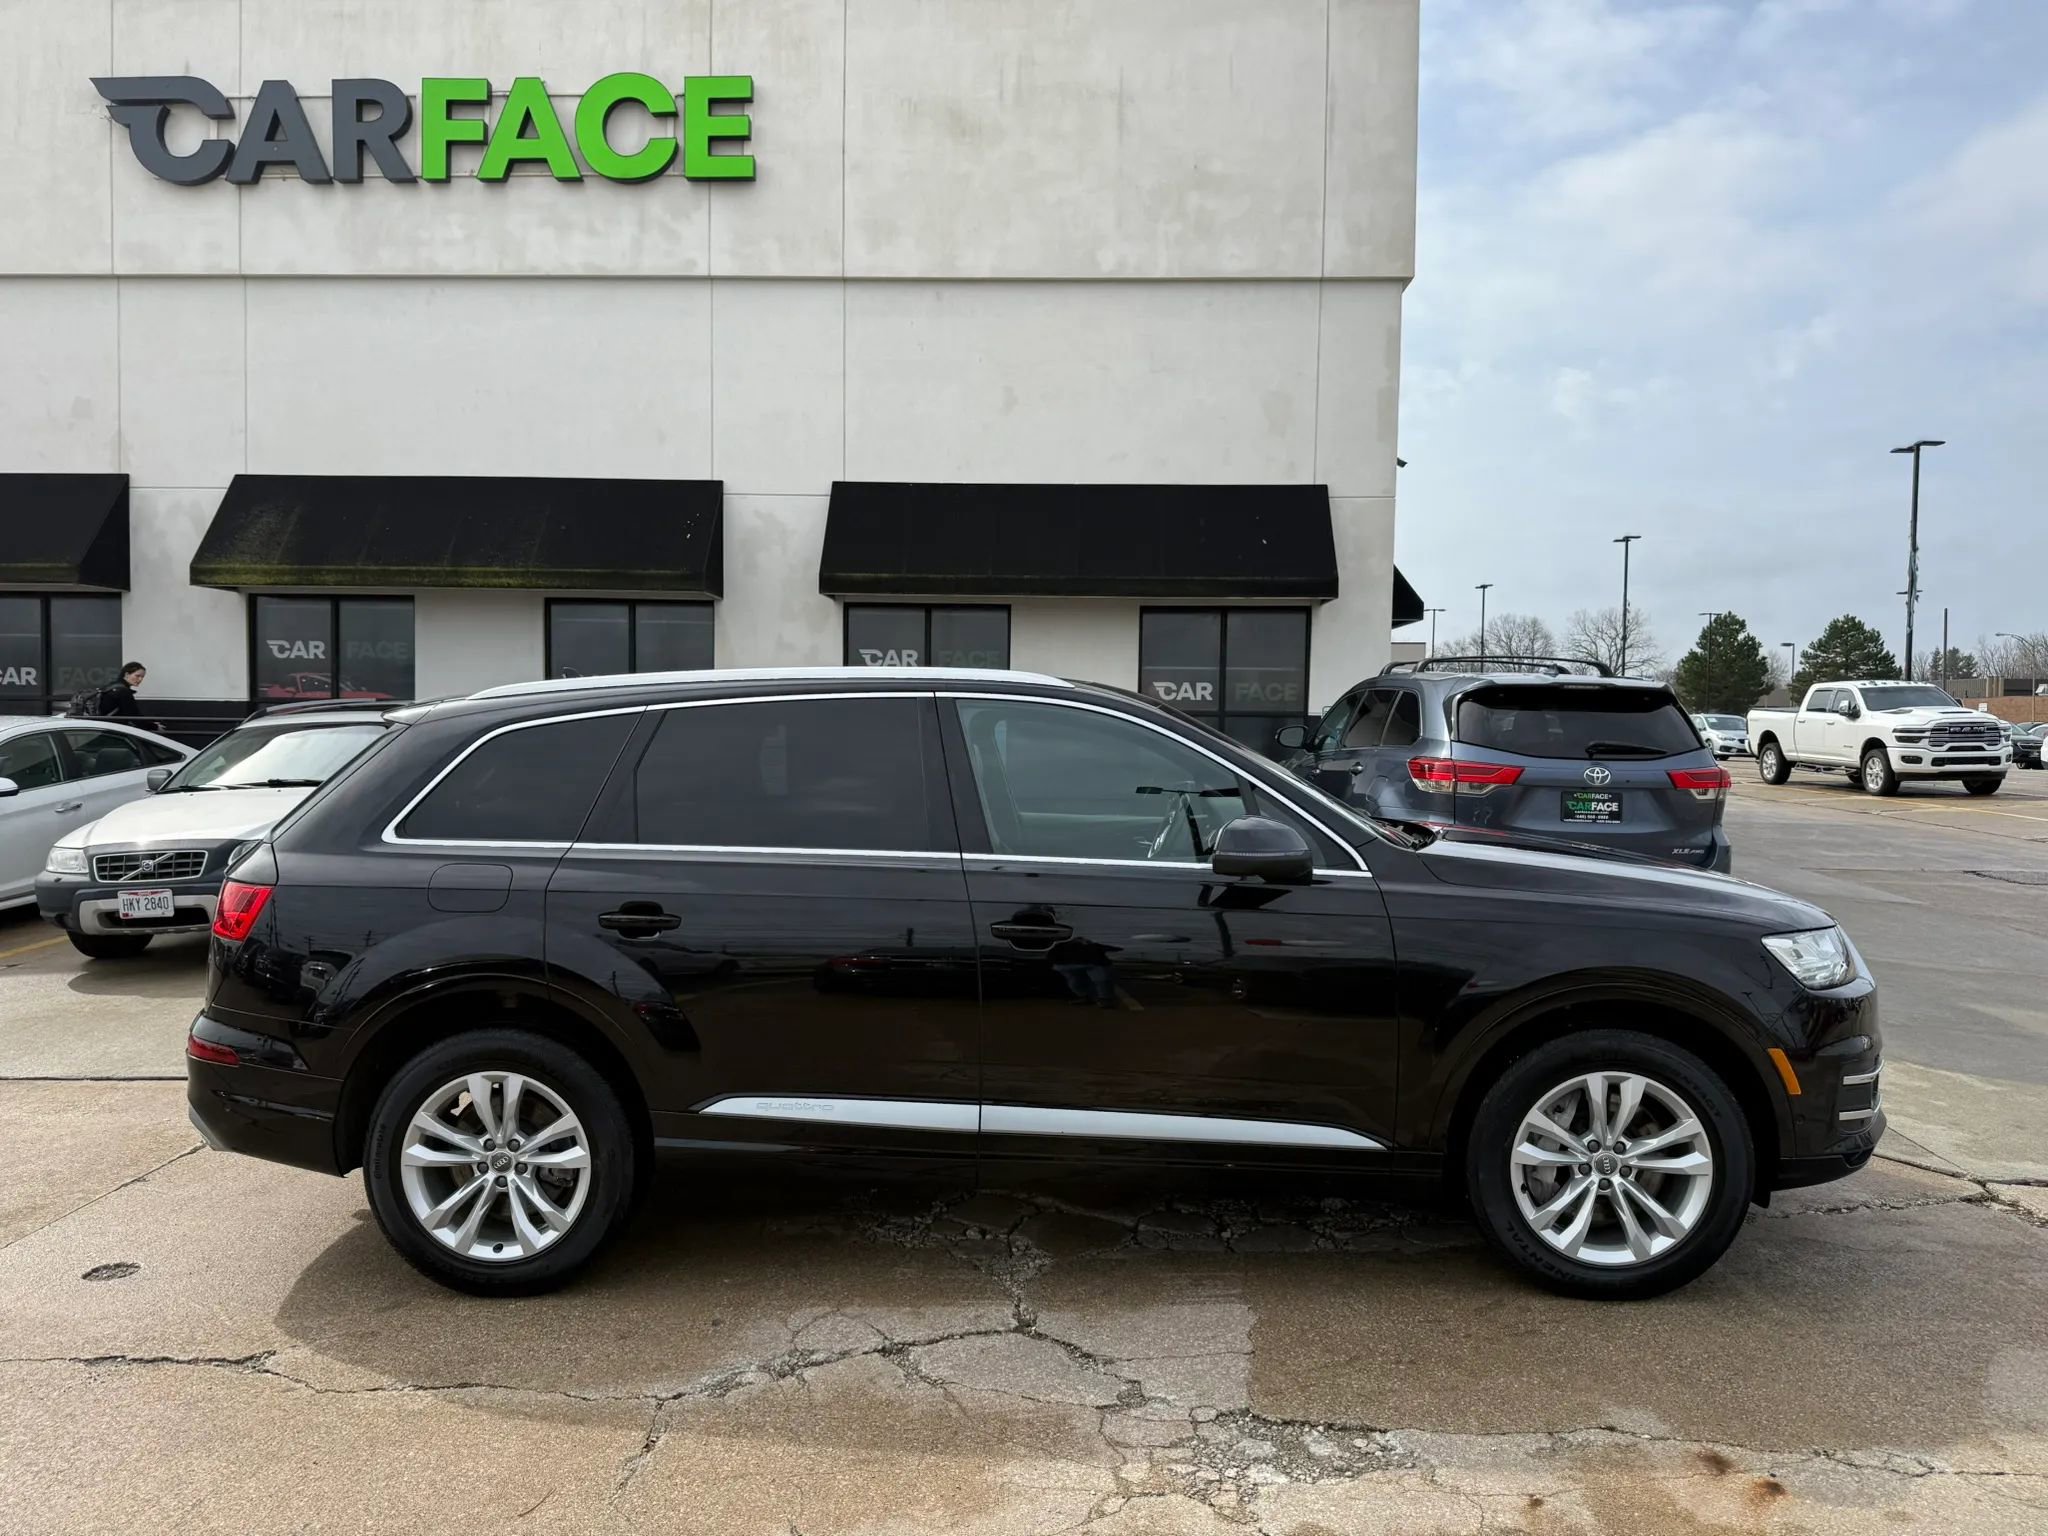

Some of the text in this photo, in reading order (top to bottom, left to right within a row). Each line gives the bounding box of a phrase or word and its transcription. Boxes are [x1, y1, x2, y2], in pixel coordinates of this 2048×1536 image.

[89, 71, 757, 185] CARFACE
[266, 640, 409, 659] CAR FACE
[858, 648, 1000, 668] CAR FACE
[0, 666, 38, 685] AR
[1152, 681, 1298, 701] CAR FACE
[1566, 801, 1619, 811] CARFACE
[144, 896, 169, 911] 2840
